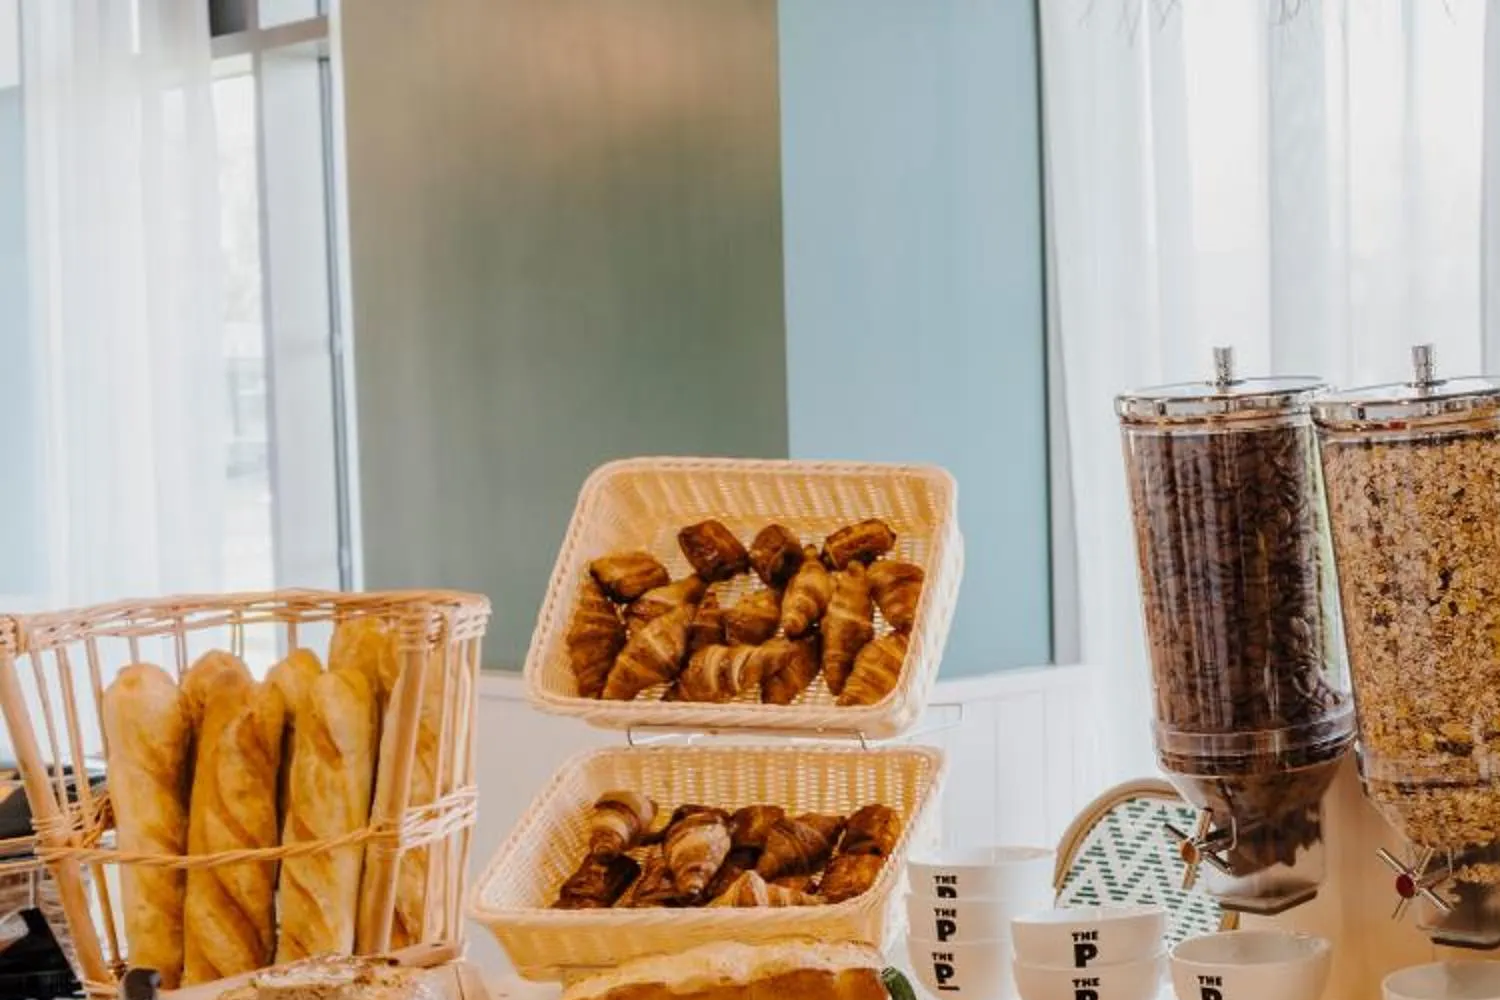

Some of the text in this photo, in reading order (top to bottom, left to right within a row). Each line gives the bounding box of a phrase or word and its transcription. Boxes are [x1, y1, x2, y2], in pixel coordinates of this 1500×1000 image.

[934, 875, 957, 885] THE
[934, 908, 957, 918] THE
[936, 919, 957, 942] P
[1071, 931, 1099, 942] THE
[932, 951, 954, 962] THE
[1073, 943, 1099, 968] P
[934, 963, 955, 985] P
[1071, 977, 1100, 989] THE
[1197, 975, 1223, 986] THE
